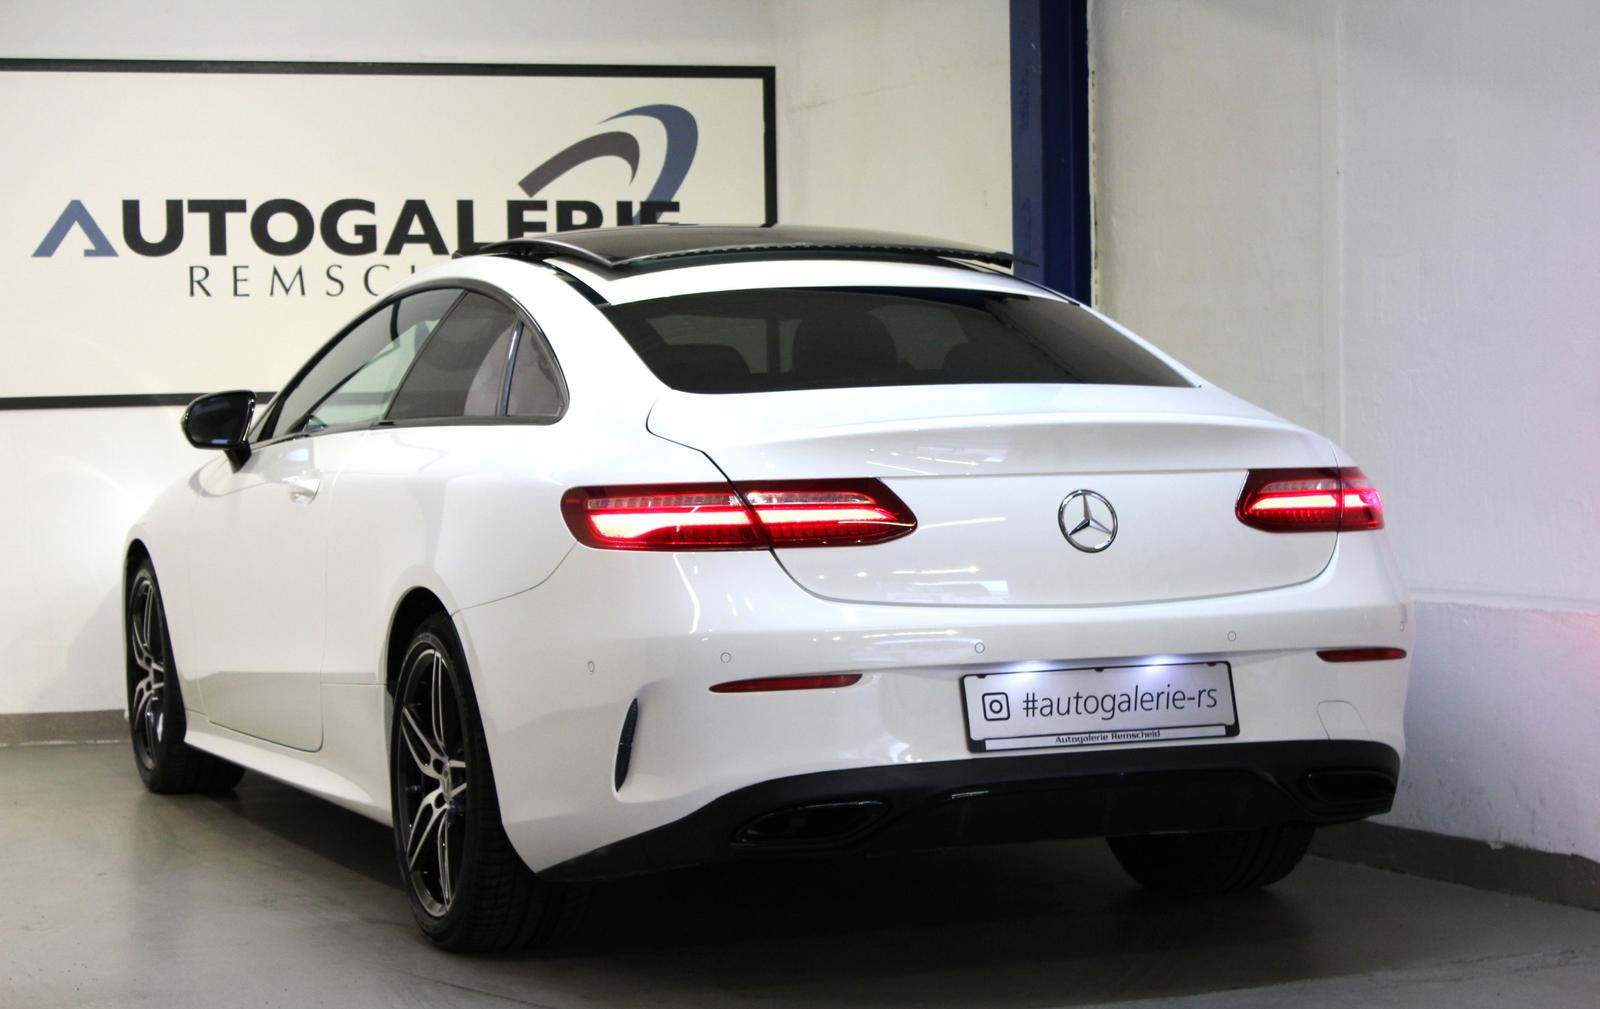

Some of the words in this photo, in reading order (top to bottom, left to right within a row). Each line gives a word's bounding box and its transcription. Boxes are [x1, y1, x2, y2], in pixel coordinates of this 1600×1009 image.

[189, 265, 416, 297] REMSC
[1022, 684, 1218, 720] #autogalerie-rs
[1055, 733, 1109, 744] Autogalerie
[1111, 729, 1161, 740] Remscheid
